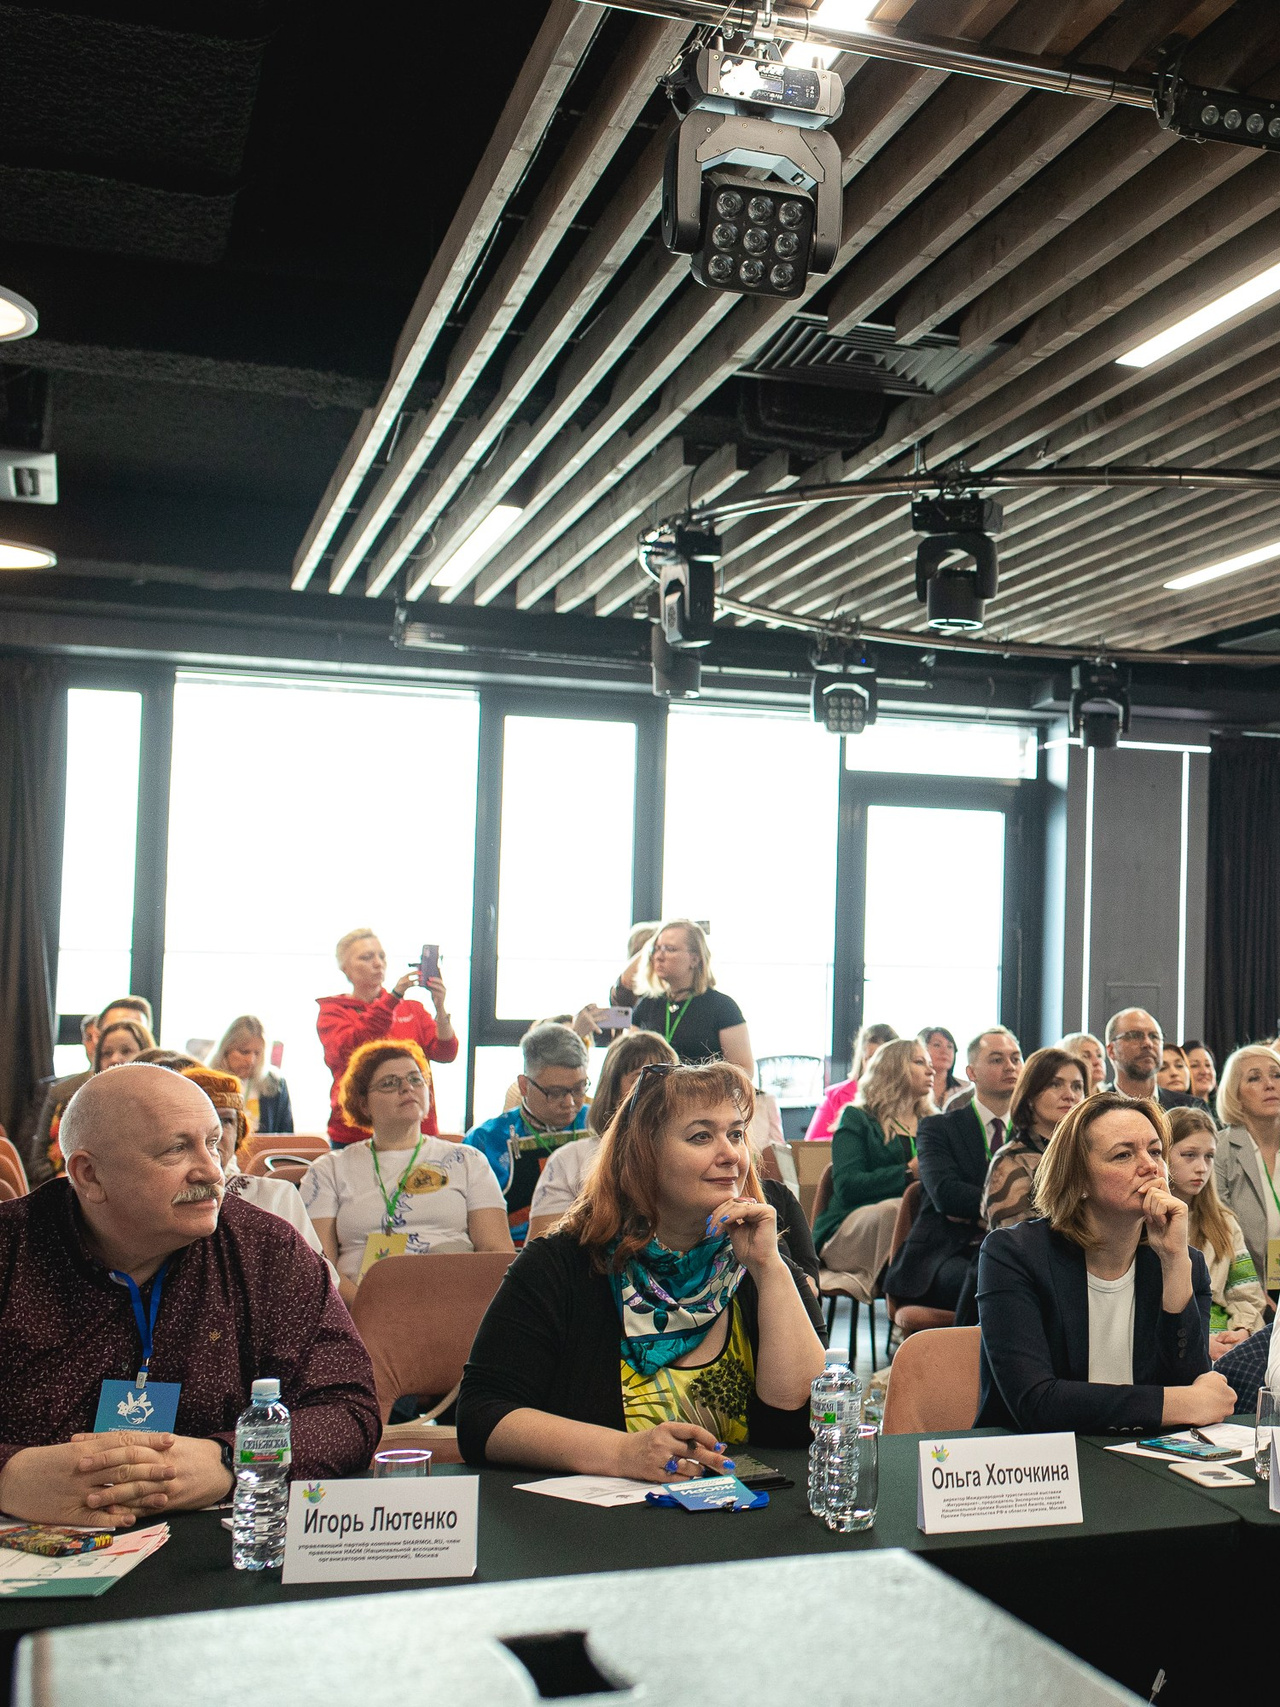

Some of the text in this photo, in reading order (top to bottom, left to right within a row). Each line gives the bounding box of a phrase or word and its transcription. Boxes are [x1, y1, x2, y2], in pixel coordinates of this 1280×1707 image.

[932, 1463, 1069, 1489] Ольга Хоточкина
[304, 1506, 458, 1539] Игорь Лютенко
